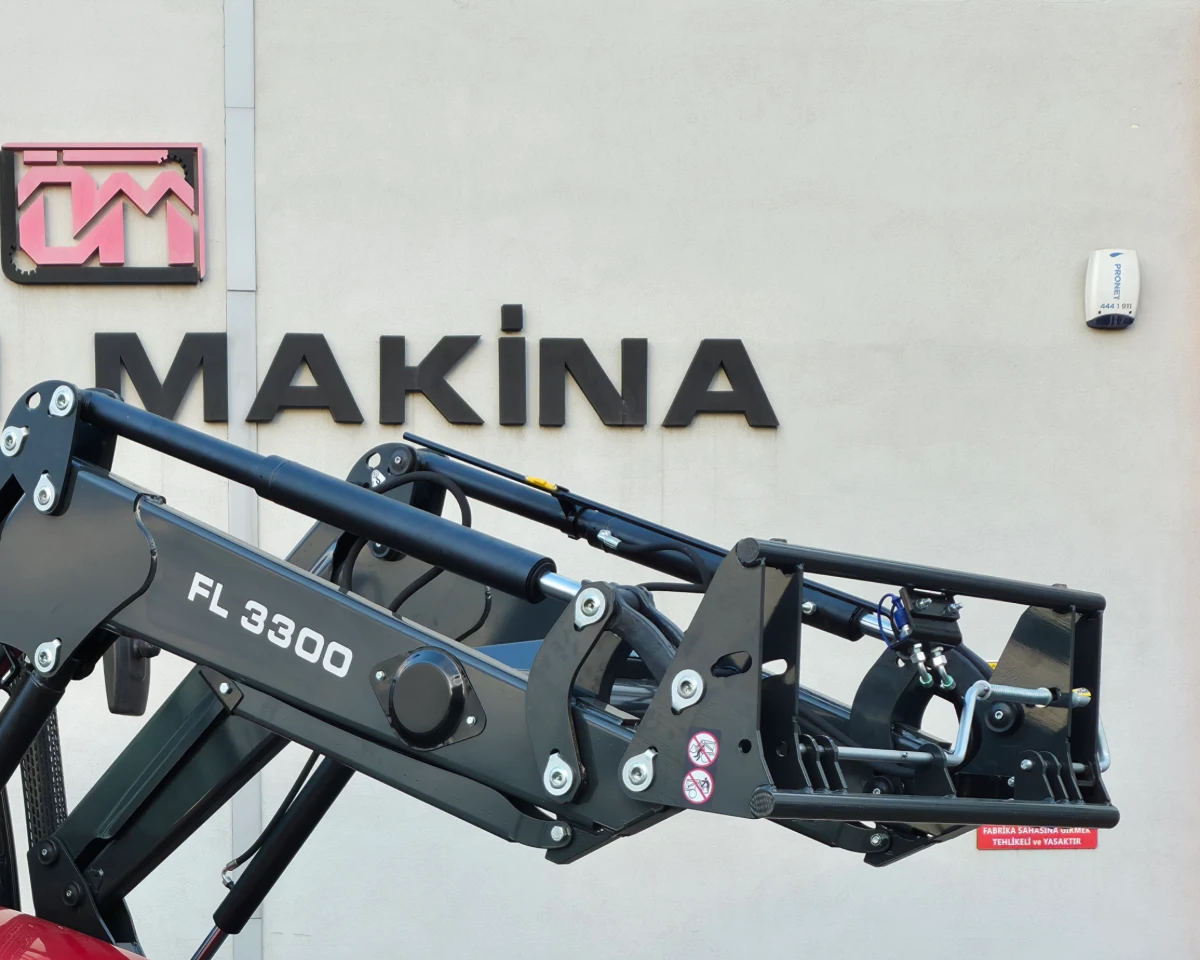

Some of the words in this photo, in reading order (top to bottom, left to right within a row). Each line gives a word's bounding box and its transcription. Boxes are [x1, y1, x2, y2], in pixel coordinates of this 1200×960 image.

[1113, 263, 1121, 300] PRONET
[94, 303, 780, 428] MAKİNA
[187, 571, 229, 619] FL
[240, 600, 353, 678] 3300
[983, 826, 1016, 835] FABRİKA
[992, 837, 1031, 846] TEHLİKELİ
[1043, 837, 1082, 846] YASAKTIR
